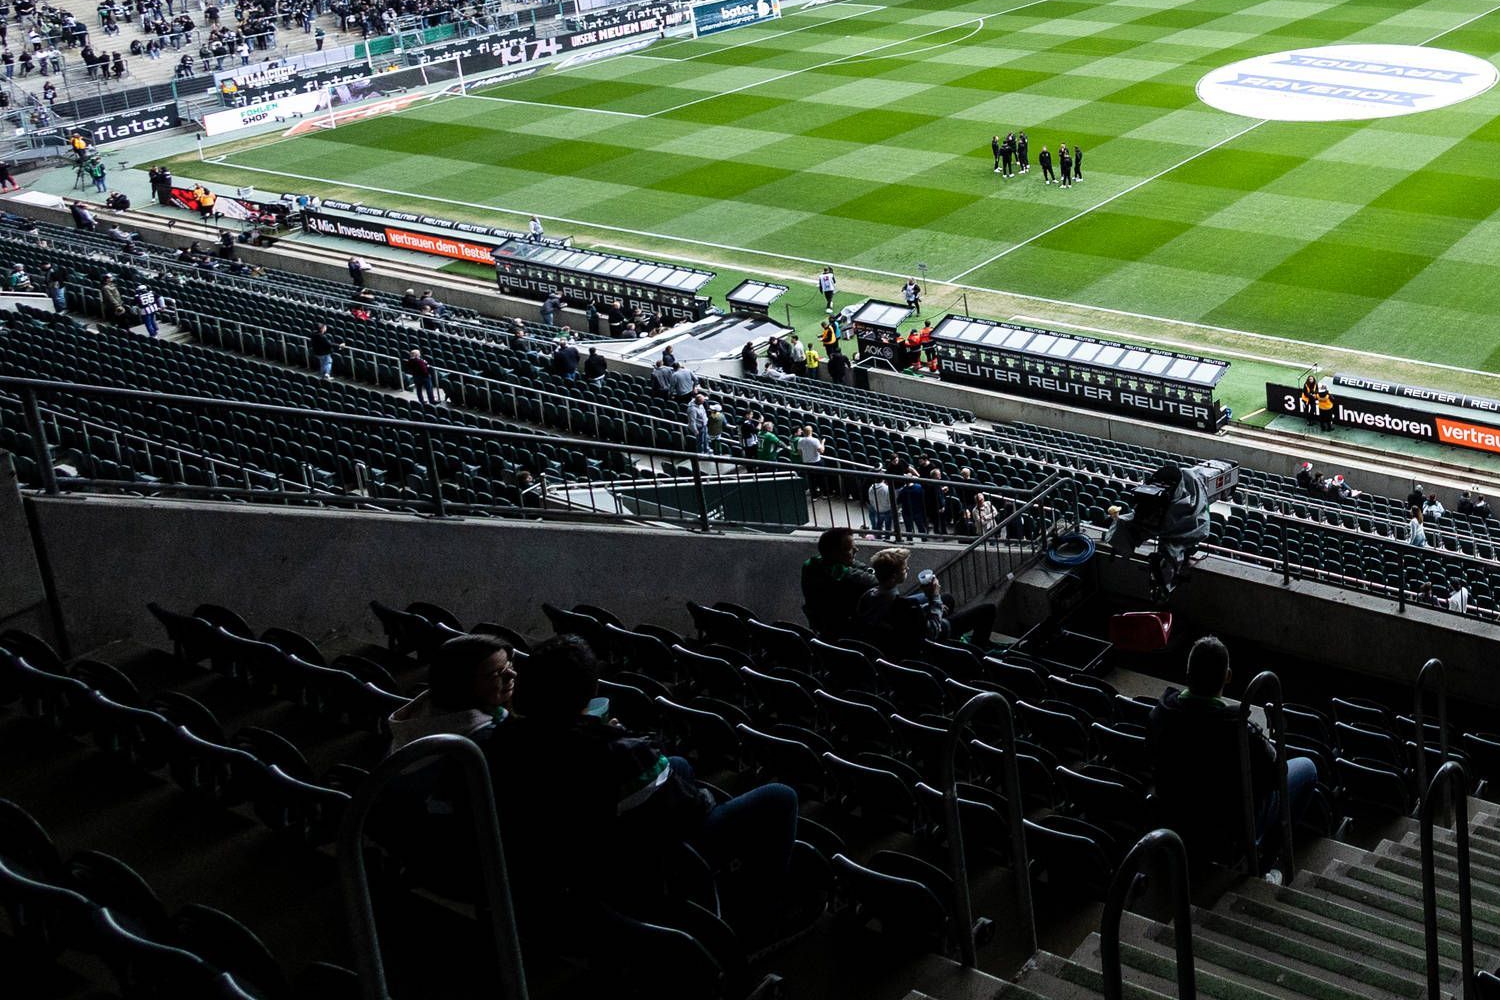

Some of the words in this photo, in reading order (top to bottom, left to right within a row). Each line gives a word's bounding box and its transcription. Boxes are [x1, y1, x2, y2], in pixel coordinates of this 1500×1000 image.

[721, 3, 754, 19] batec
[570, 32, 597, 47] UNSERE
[599, 21, 640, 41] NEUEN
[1241, 78, 1409, 102] RAVENOL
[242, 113, 268, 126] SHOP
[389, 211, 418, 222] REUTER
[423, 217, 451, 228] REUTER
[310, 217, 317, 229] 3
[317, 219, 336, 234] Mio.
[337, 222, 387, 243] Investoren
[390, 234, 436, 250] vertrauen
[436, 239, 458, 254] dem
[458, 223, 487, 234] REUTER
[500, 275, 557, 294] REUTER
[864, 345, 882, 356] AOK
[941, 358, 1021, 384] REUTER
[1028, 375, 1113, 401] REUTER
[1120, 392, 1209, 420] REUTER
[1339, 376, 1390, 392] REUTER
[1403, 388, 1456, 403] REUTER
[1283, 394, 1296, 411] 3
[1339, 404, 1432, 437] Investoren
